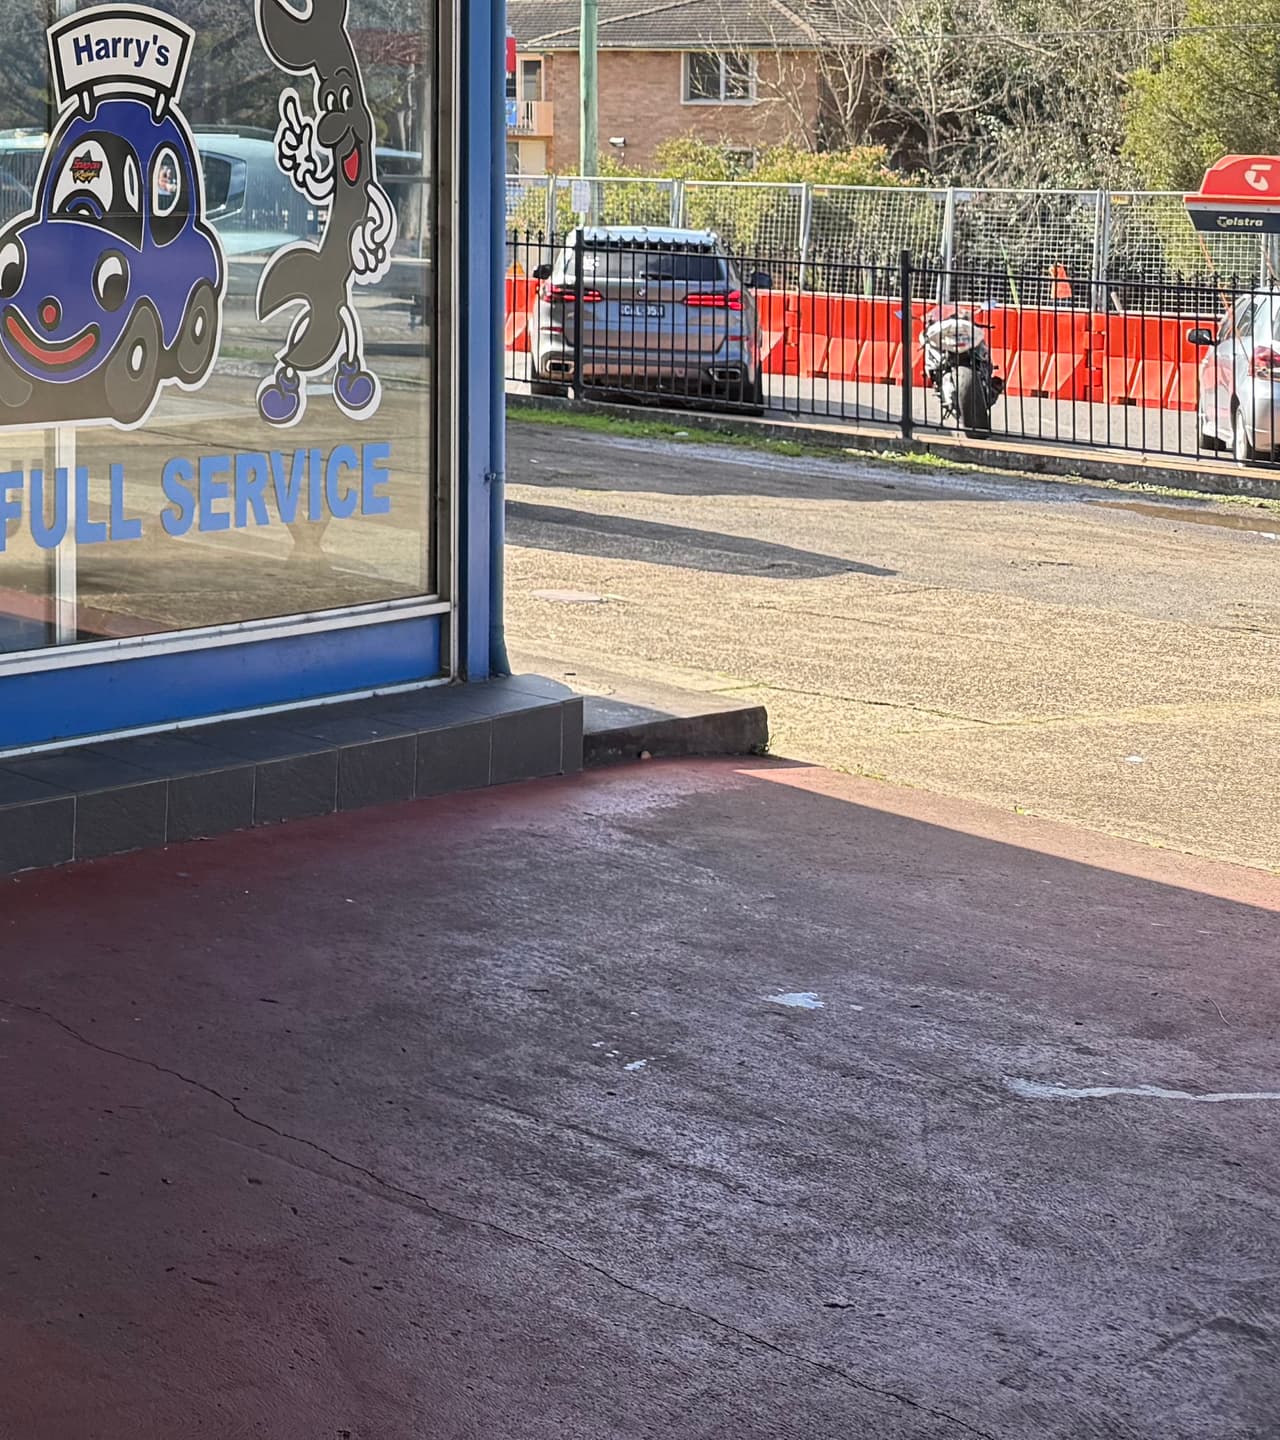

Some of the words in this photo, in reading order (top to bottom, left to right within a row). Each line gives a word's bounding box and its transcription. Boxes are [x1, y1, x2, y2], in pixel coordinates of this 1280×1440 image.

[71, 33, 171, 68] Harry's
[1216, 216, 1263, 228] Telstra
[160, 441, 392, 538] SERVICE
